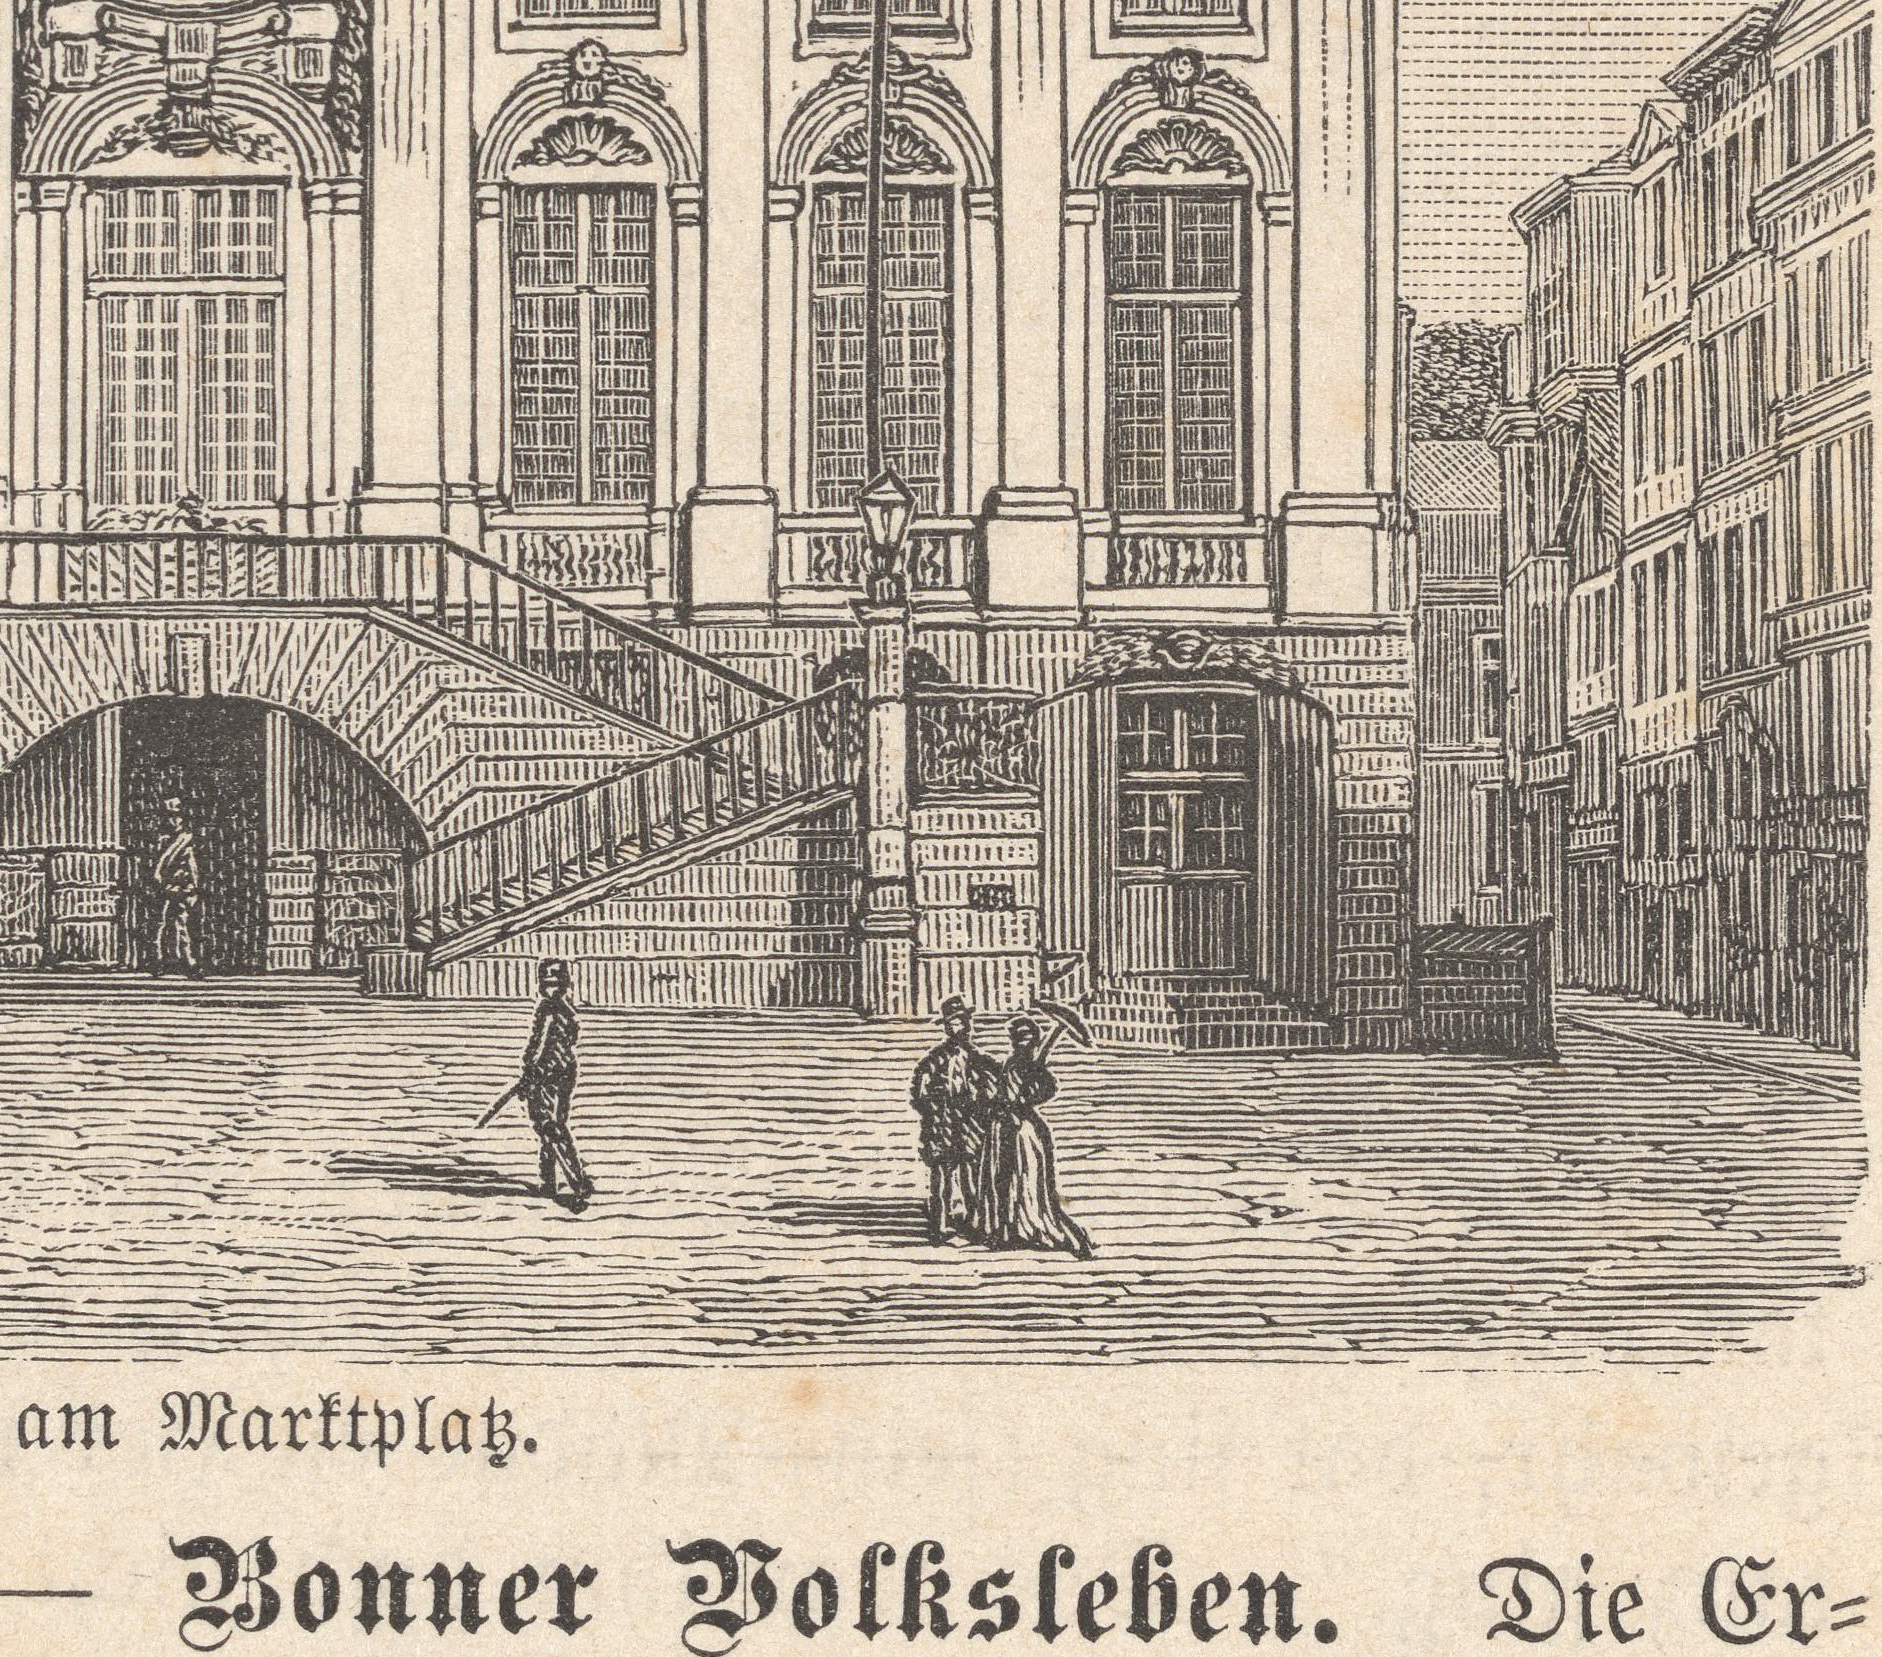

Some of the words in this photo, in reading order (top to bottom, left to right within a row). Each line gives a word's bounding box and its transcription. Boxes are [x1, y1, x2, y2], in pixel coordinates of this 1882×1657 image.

[17, 1402, 120, 1451] am
[159, 1390, 538, 1469] Marktplatz.
[168, 1534, 599, 1653] Bonner
[665, 1537, 1338, 1657] Volksleben.
[1478, 1552, 1645, 1645] Die
